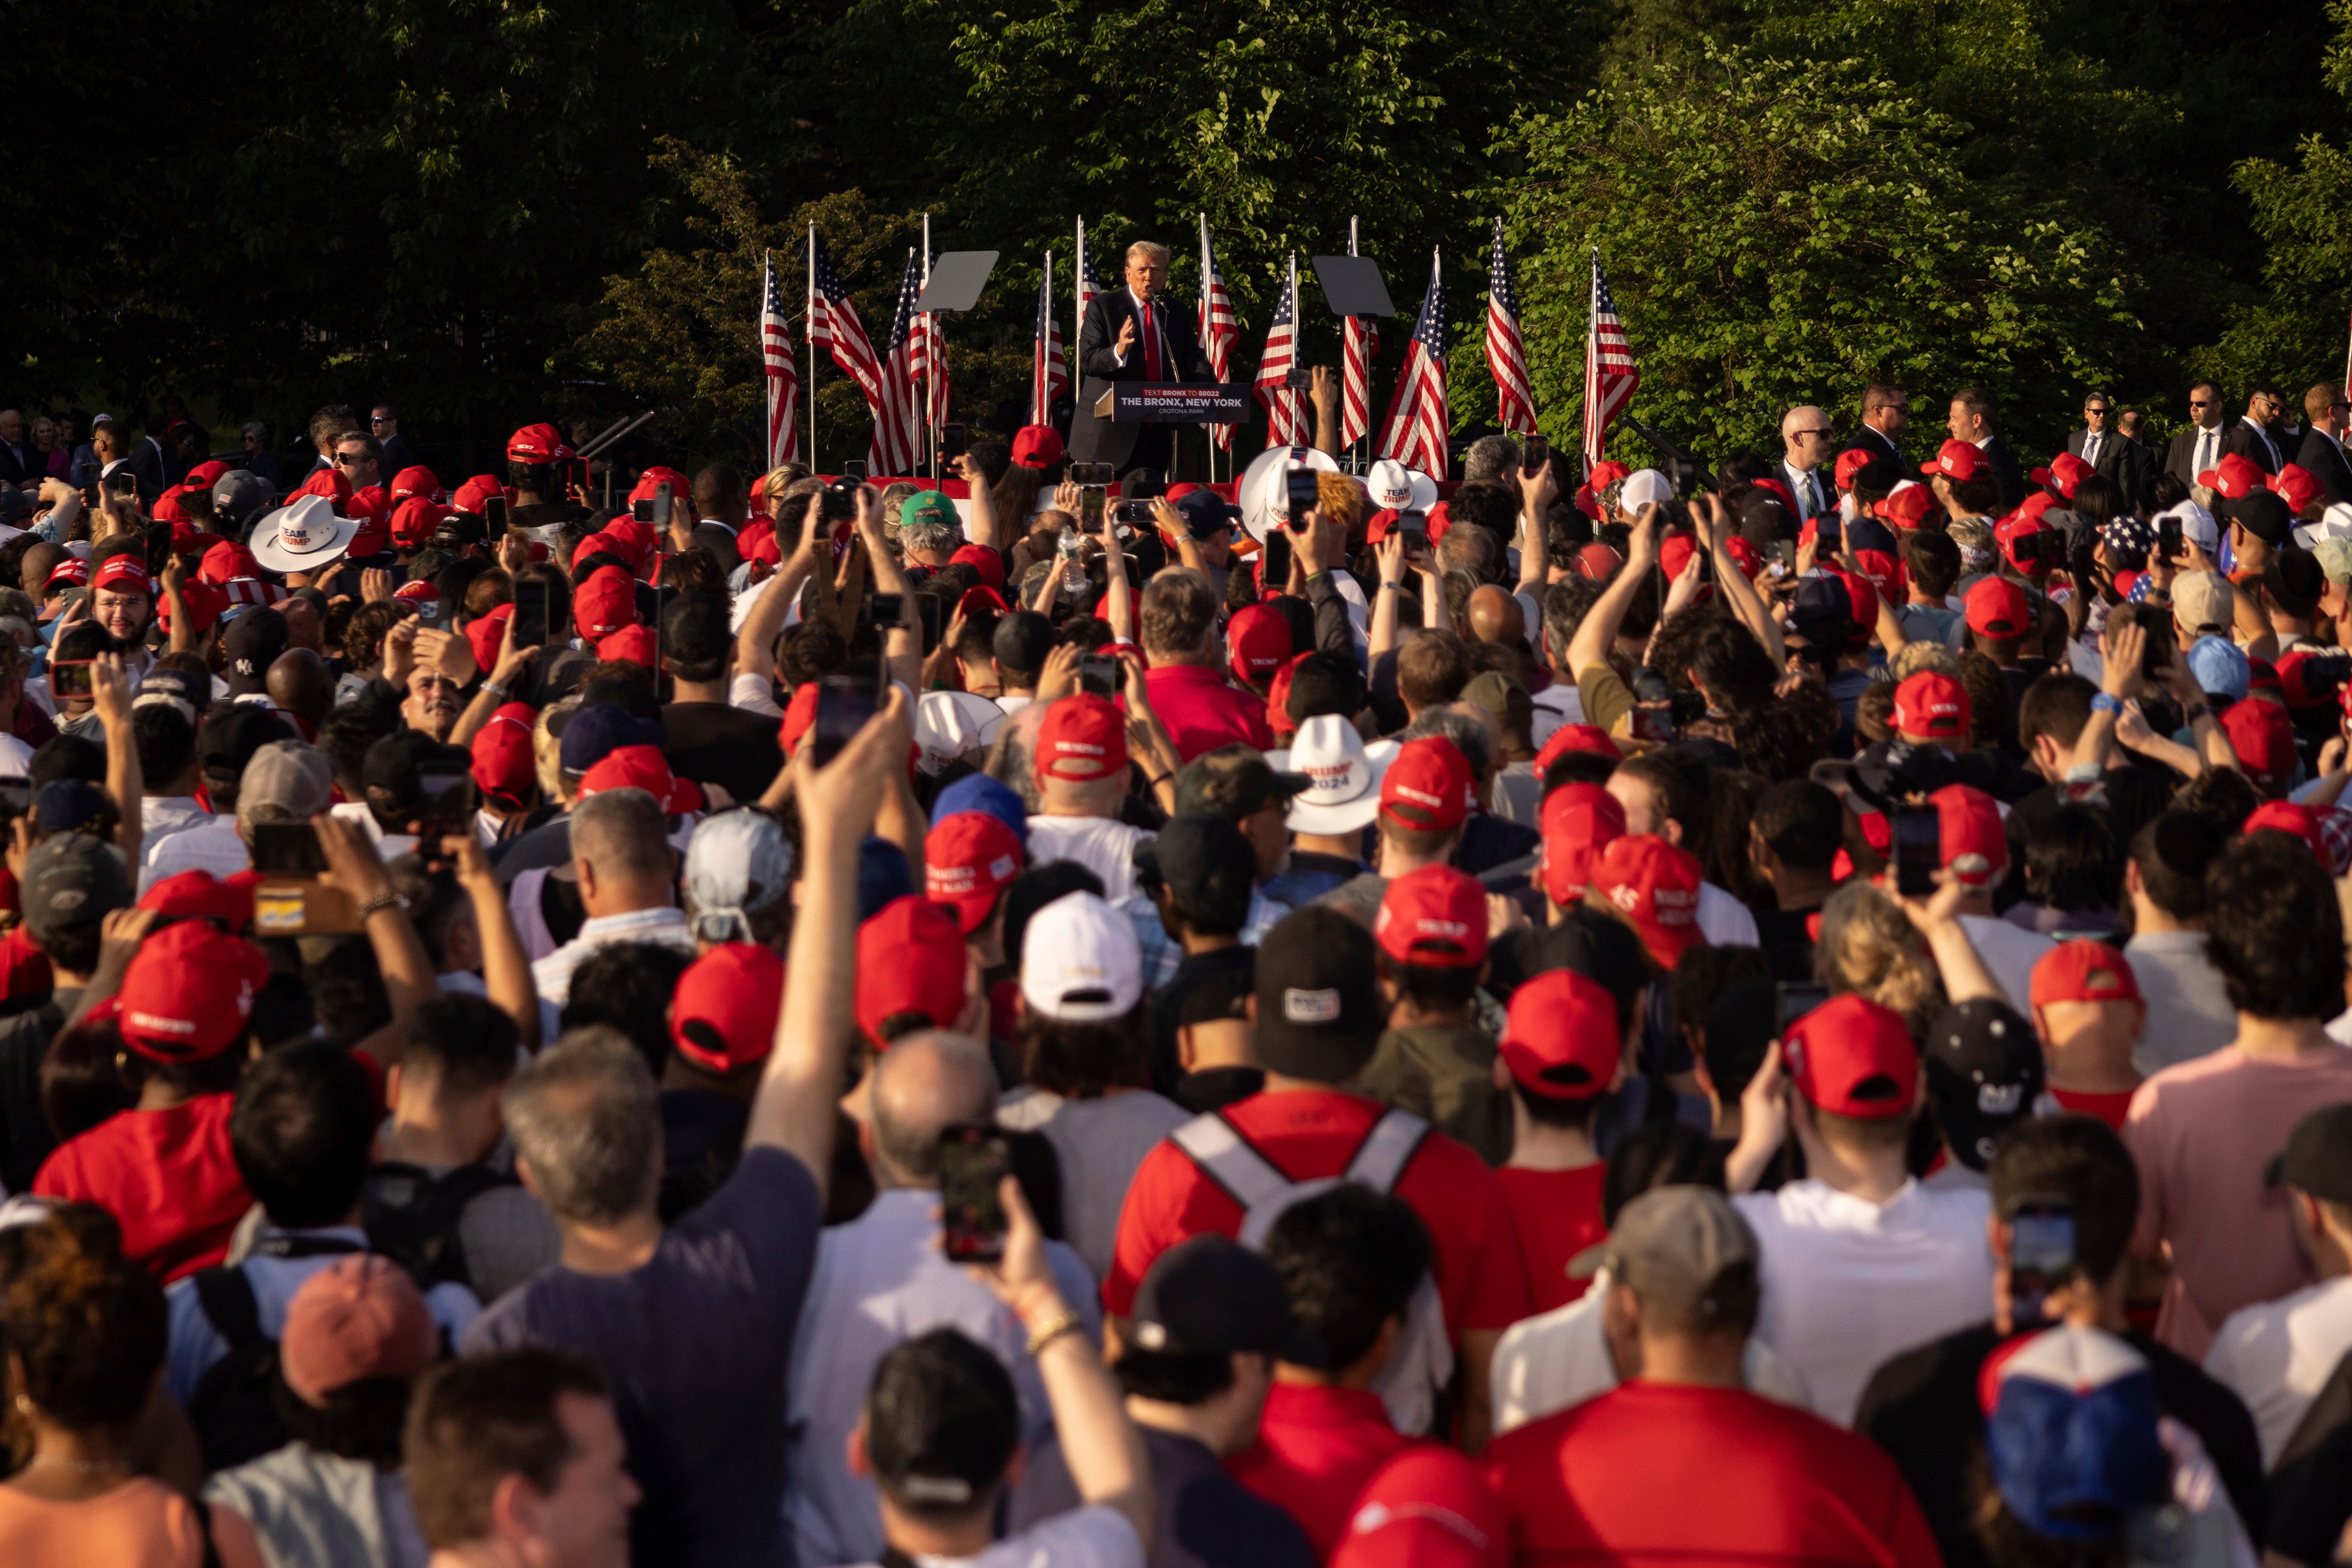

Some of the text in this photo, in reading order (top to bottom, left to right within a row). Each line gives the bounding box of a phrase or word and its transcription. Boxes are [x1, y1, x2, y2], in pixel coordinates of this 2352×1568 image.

[1144, 398, 1184, 407] BRONX,
[1213, 399, 1242, 407] YORK
[1386, 487, 1410, 496] TEAM
[1383, 492, 1411, 503] TRUMP
[282, 526, 307, 538] TEAM
